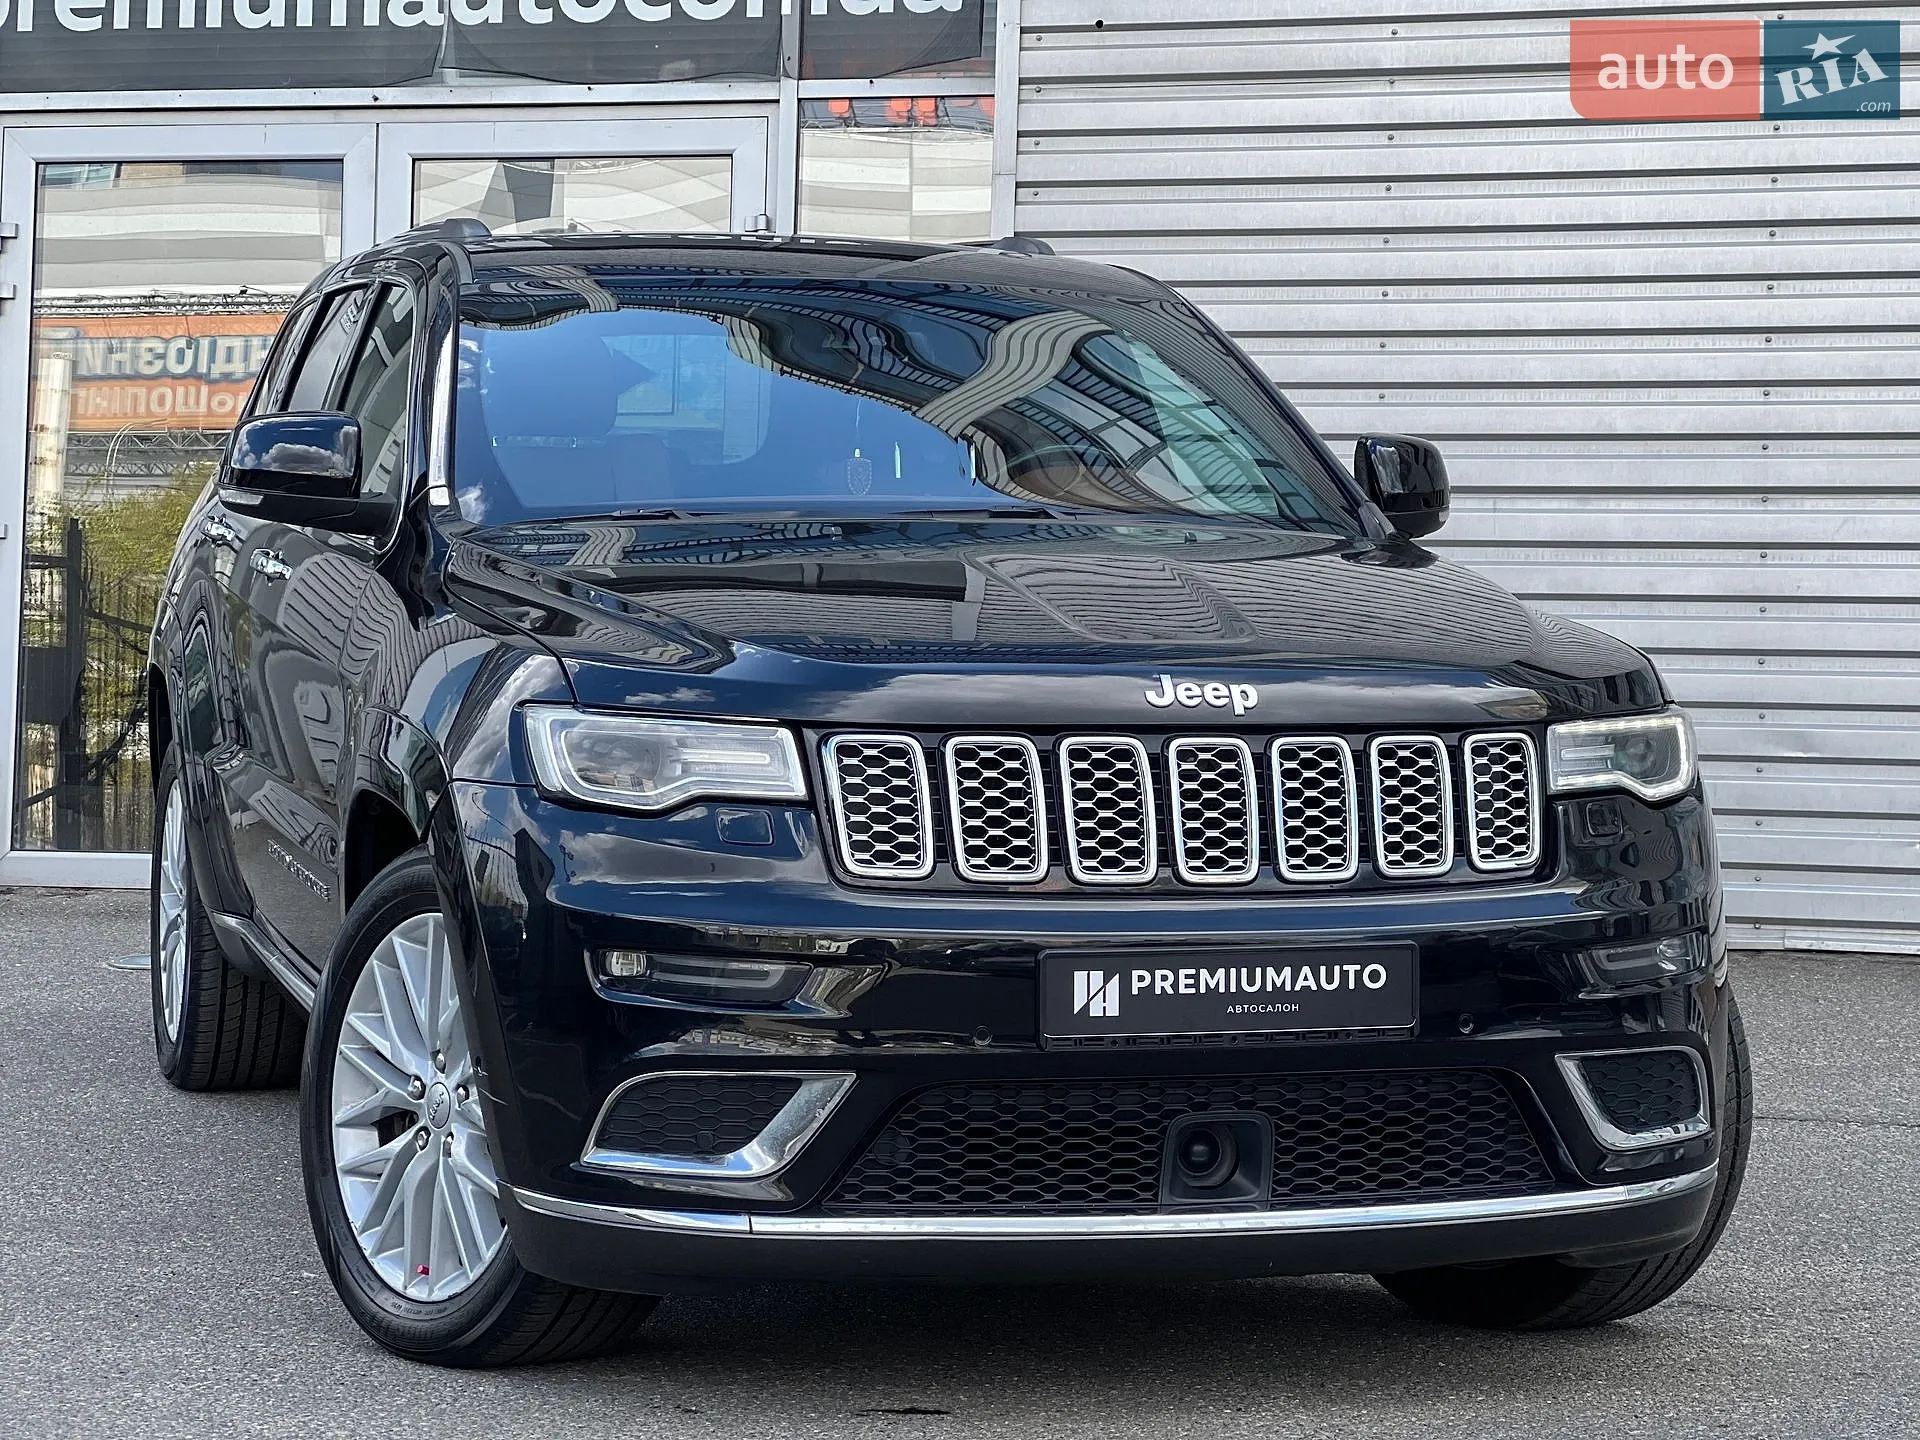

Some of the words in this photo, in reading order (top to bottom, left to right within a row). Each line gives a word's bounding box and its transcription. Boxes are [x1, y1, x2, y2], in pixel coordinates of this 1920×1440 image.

[1144, 673, 1259, 716] Jeep
[1131, 963, 1388, 995] PREMIUMAUTO
[1226, 1003, 1300, 1014] АВТОСАЛОН
